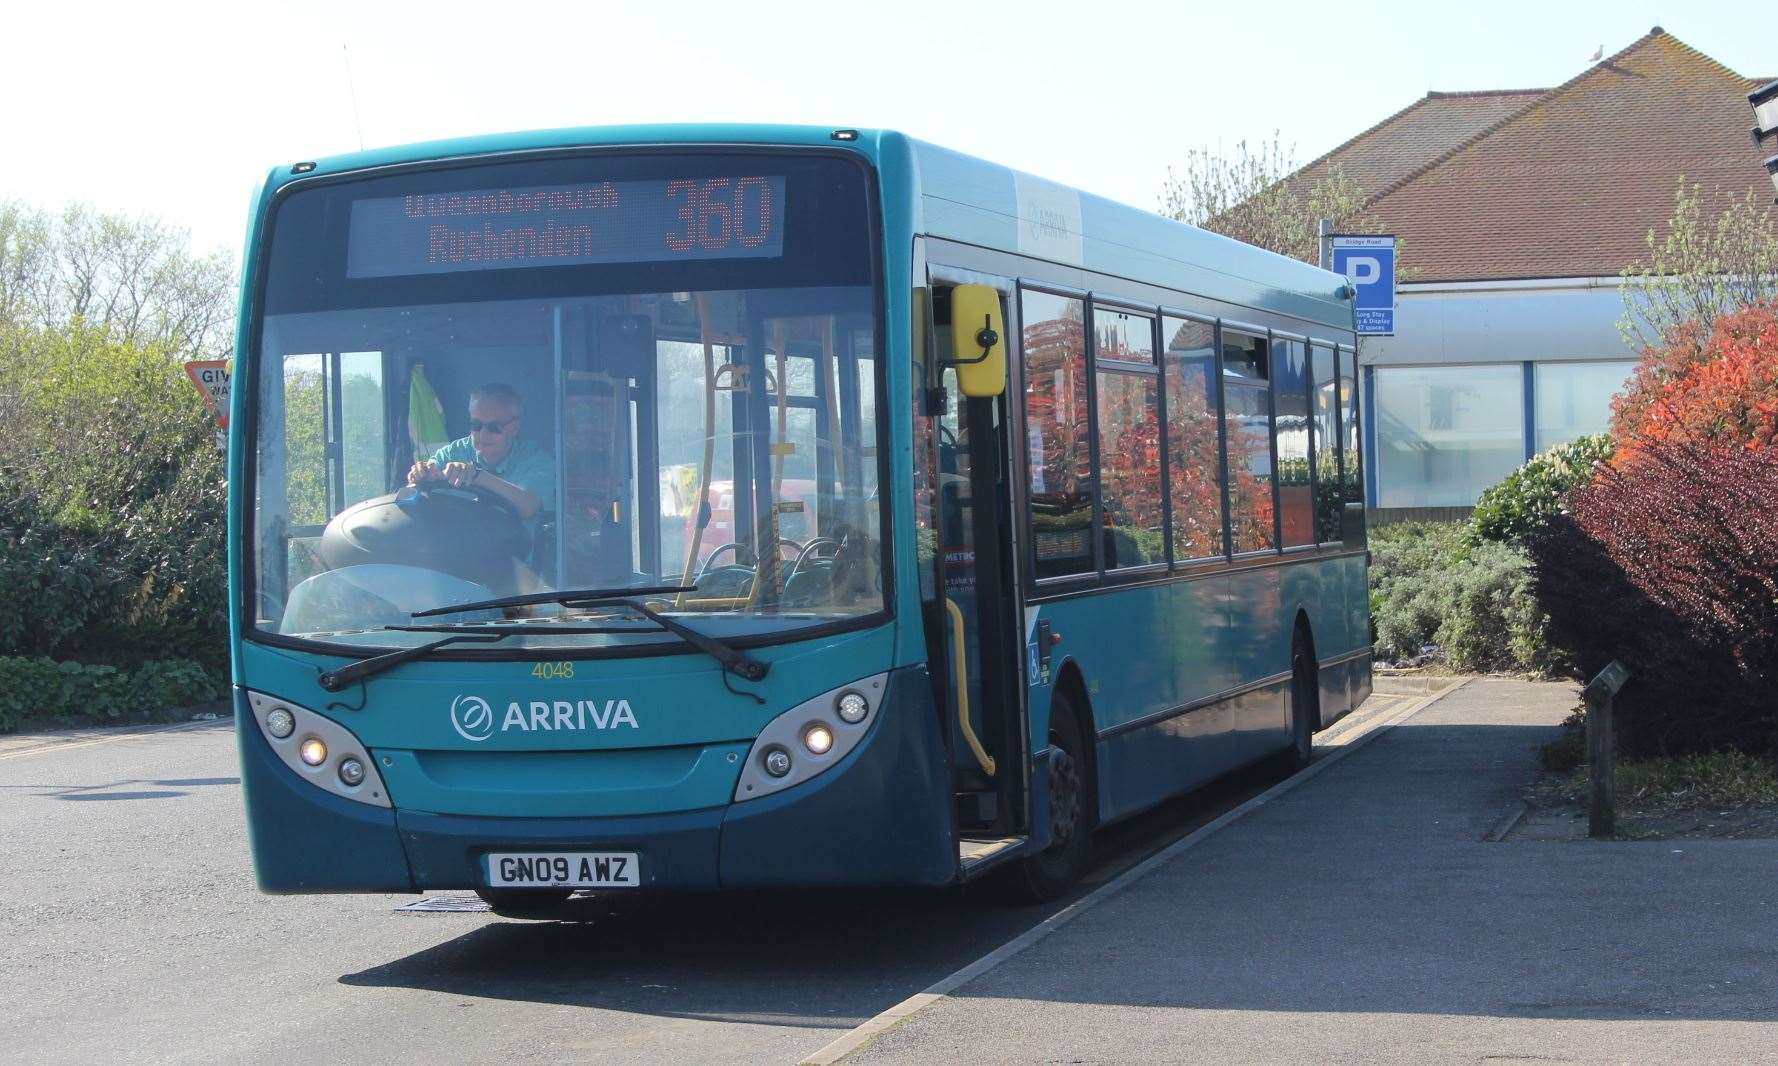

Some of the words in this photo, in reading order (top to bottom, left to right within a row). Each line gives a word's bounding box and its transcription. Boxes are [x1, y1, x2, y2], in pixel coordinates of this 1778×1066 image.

[666, 177, 769, 251] 360
[428, 220, 592, 264] Rushenden
[1346, 257, 1380, 299] P
[202, 370, 230, 383] GIV
[210, 386, 231, 395] WA
[531, 662, 574, 679] 4048
[501, 700, 639, 731] ARRIVA
[501, 857, 569, 882] GN09
[578, 857, 629, 882] AWZ
